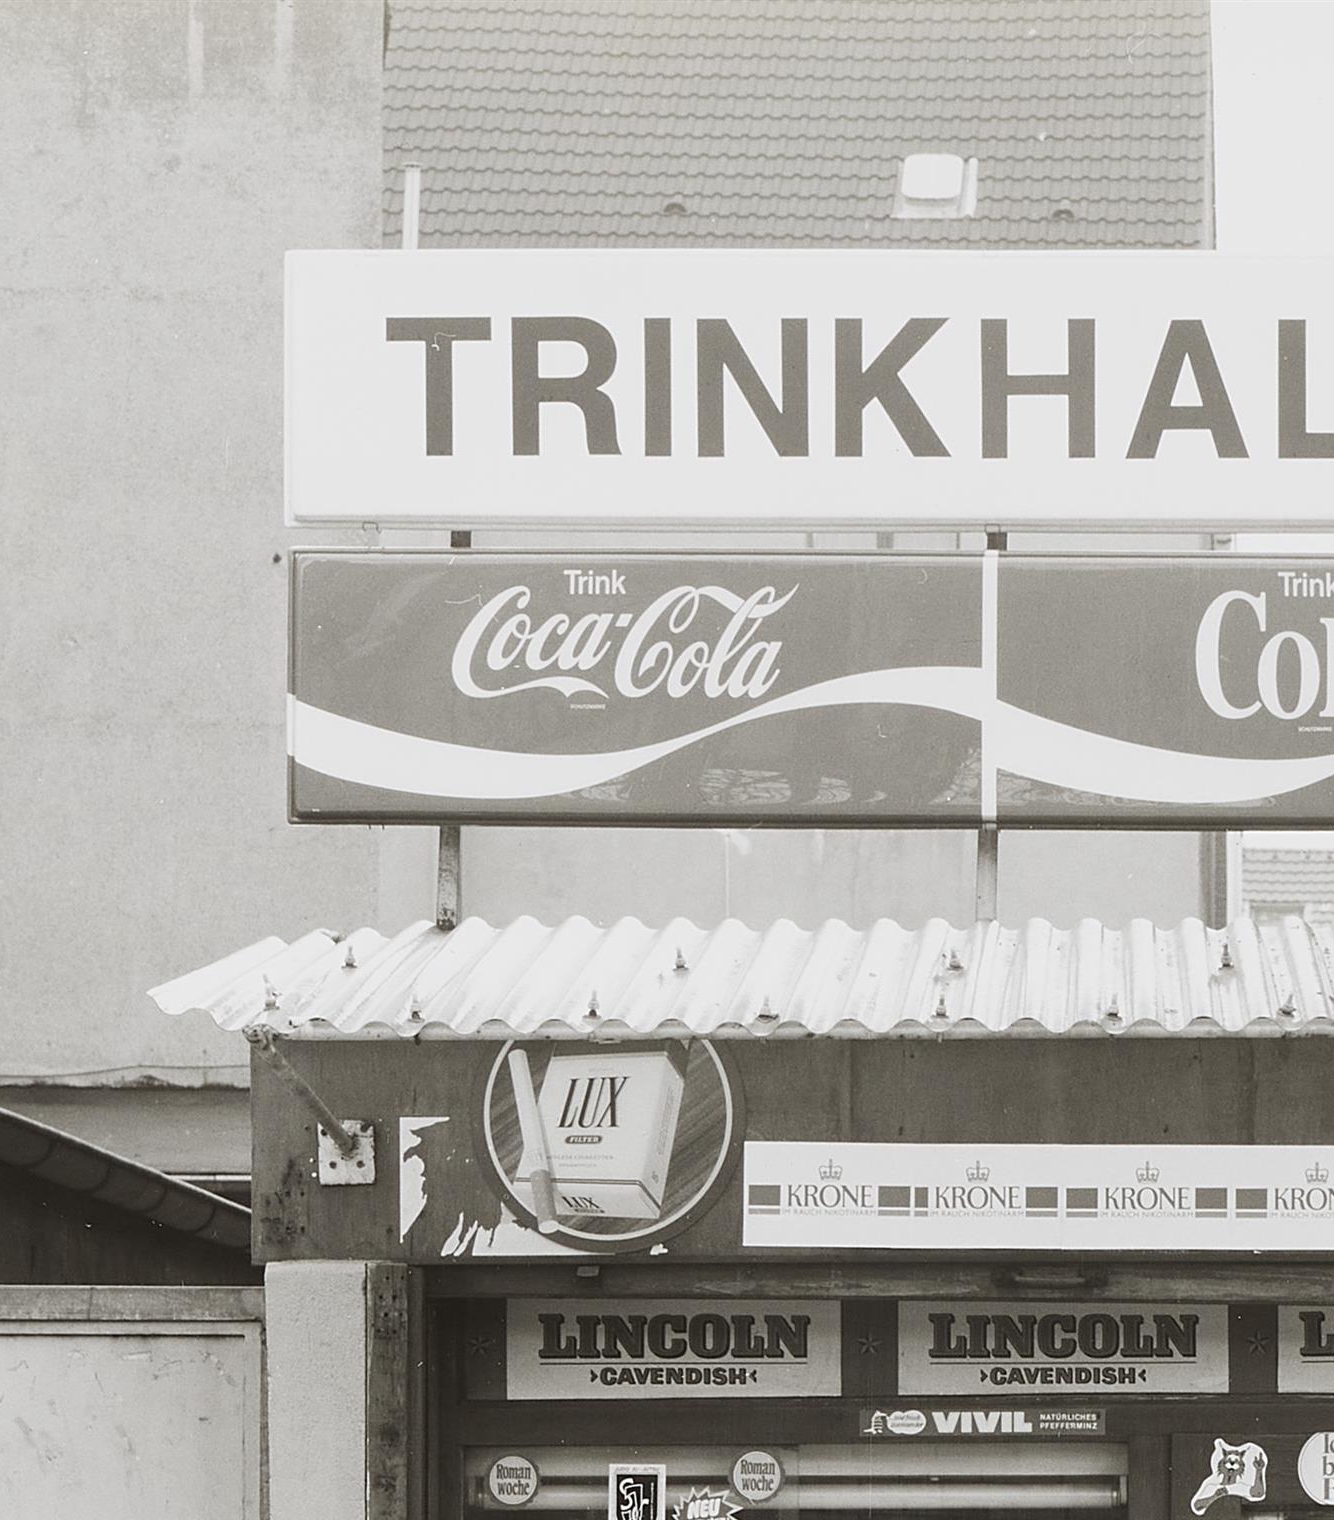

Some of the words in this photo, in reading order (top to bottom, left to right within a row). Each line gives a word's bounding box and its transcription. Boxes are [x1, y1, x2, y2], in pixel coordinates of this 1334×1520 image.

[563, 570, 626, 595] Trink
[451, 583, 800, 699] Coca-Cola
[557, 1076, 631, 1129] LUX
[568, 1135, 601, 1144] FILTER
[788, 1184, 873, 1208] KRONE
[935, 1186, 1019, 1209] KRONE
[1105, 1187, 1191, 1211] KRONE
[538, 1312, 808, 1359] LINCOLN
[928, 1312, 1198, 1359] LINCOLN
[932, 1411, 1033, 1433] VIVIL
[1039, 1412, 1098, 1421] NATÜRLICHES
[1039, 1421, 1098, 1430] PFEFFERMINZ
[496, 1463, 531, 1481] Roman
[740, 1458, 776, 1476] Roman
[497, 1480, 530, 1497] woche
[742, 1475, 774, 1492] woche
[687, 1498, 722, 1519] NEU
